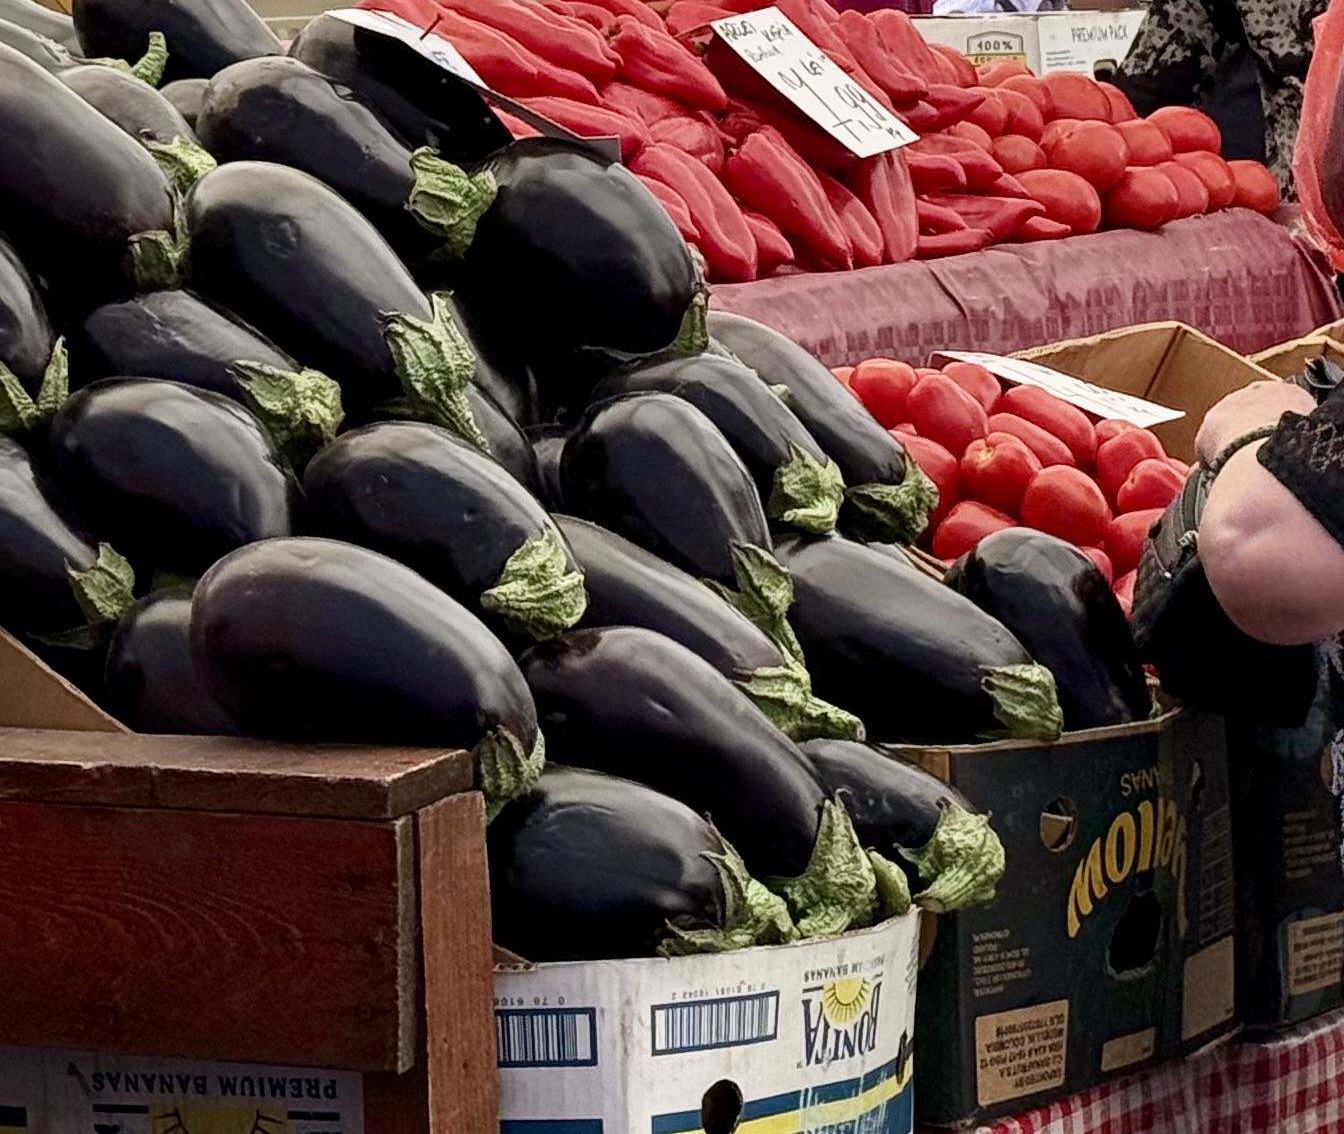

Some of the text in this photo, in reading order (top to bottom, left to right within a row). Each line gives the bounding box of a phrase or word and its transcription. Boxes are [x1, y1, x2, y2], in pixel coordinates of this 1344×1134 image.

[1071, 24, 1129, 44] PREMIUM PACK
[976, 40, 1013, 52] 100%
[803, 963, 849, 984] BANANAS
[802, 981, 883, 1067] BONITA
[92, 1072, 338, 1099] PREMIUM BANANAS
